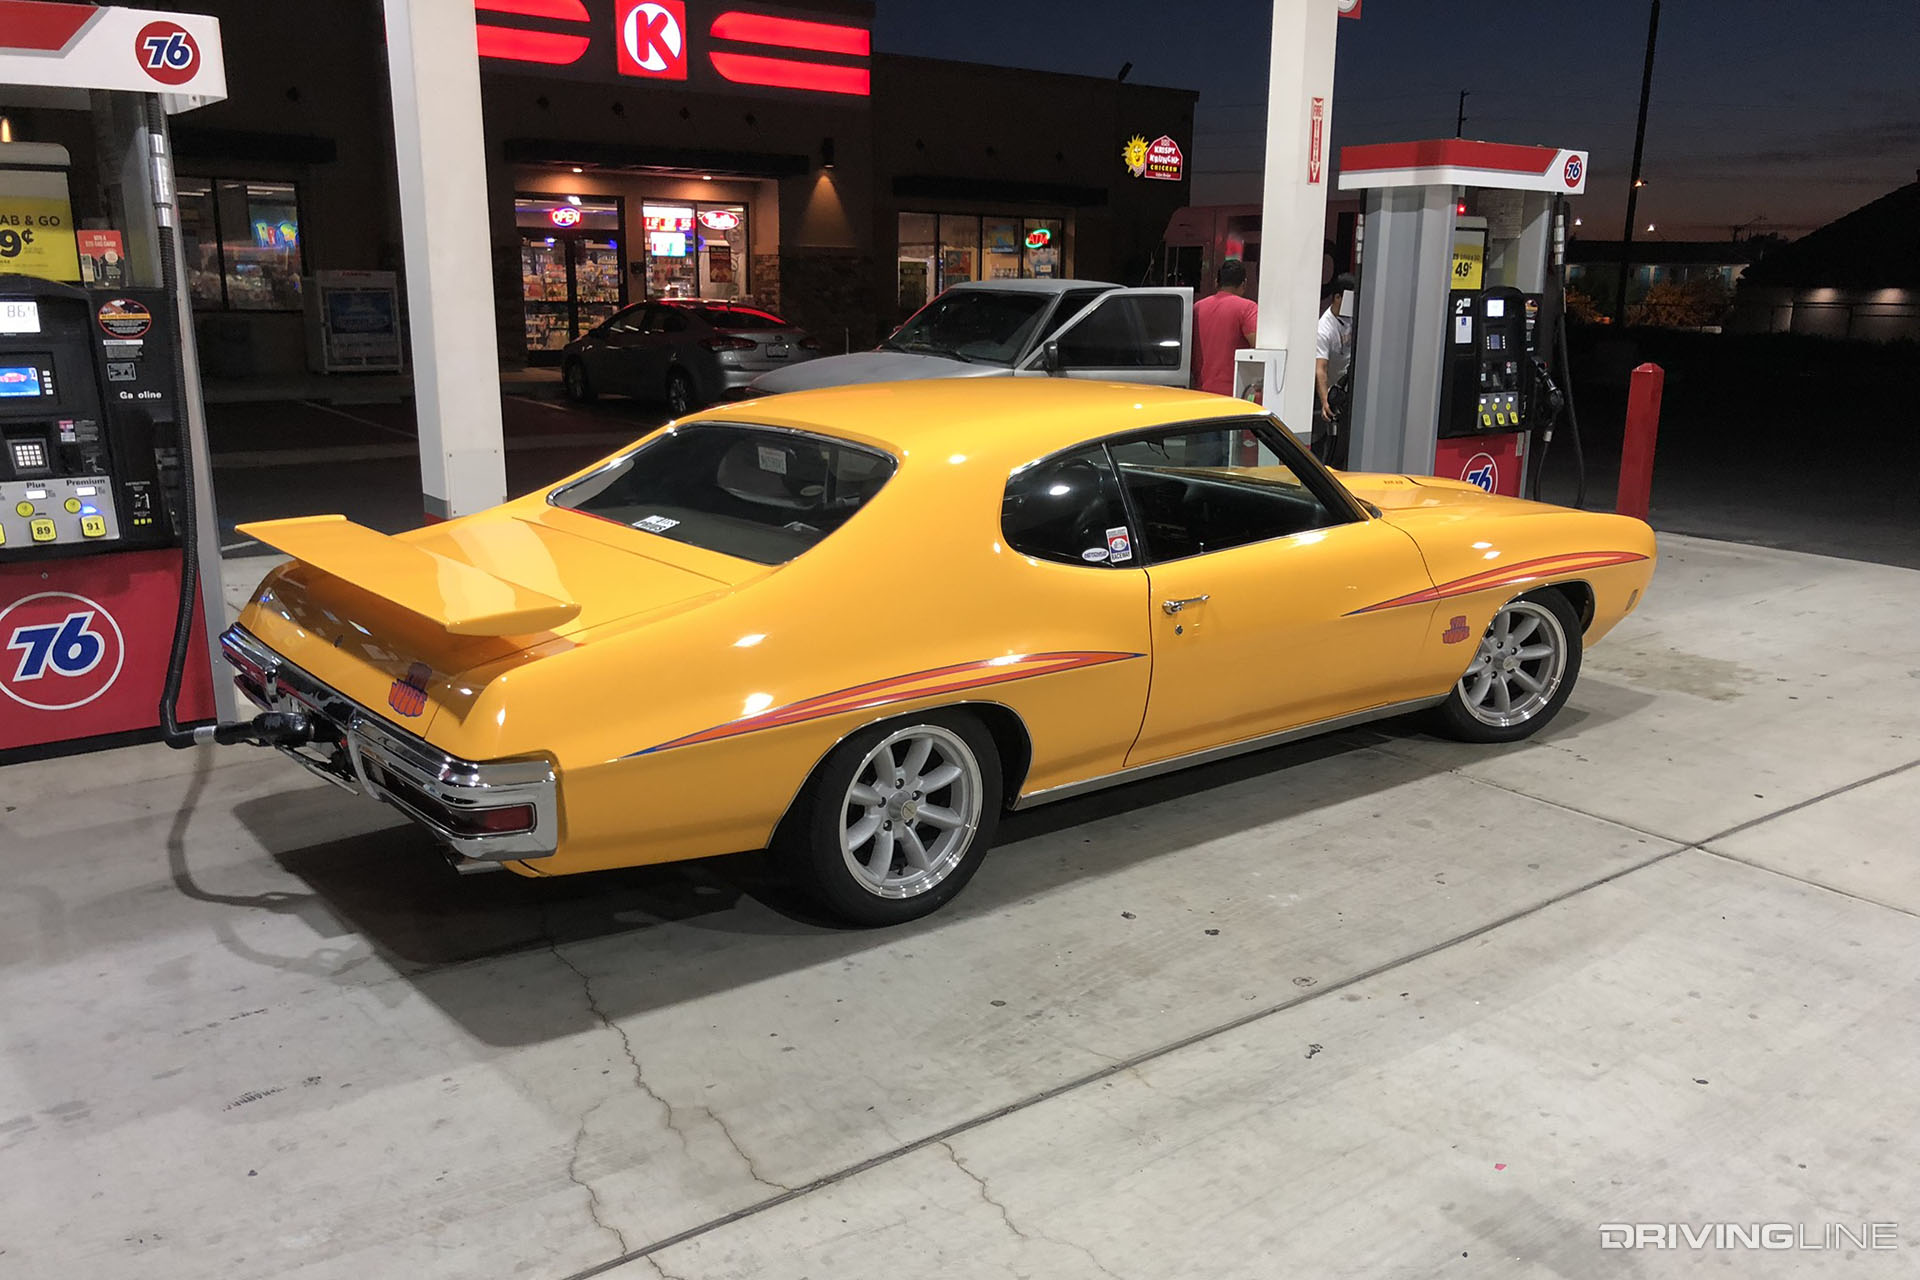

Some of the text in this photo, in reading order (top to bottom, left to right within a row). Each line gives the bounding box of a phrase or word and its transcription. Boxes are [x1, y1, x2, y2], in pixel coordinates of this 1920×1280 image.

[636, 10, 678, 70] K
[143, 32, 193, 70] 76
[1154, 146, 1176, 154] KRISPY
[1150, 164, 1178, 172] CHICKEN
[1566, 160, 1581, 180] 76
[24, 215, 34, 226] &
[38, 216, 60, 226] GO
[552, 211, 581, 224] OPEN
[1028, 233, 1048, 245] ATM
[1455, 299, 1464, 314] 2
[26, 478, 106, 489] Plus Premium
[36, 526, 51, 535] 89
[86, 521, 100, 530] 91
[6, 611, 105, 682] 76
